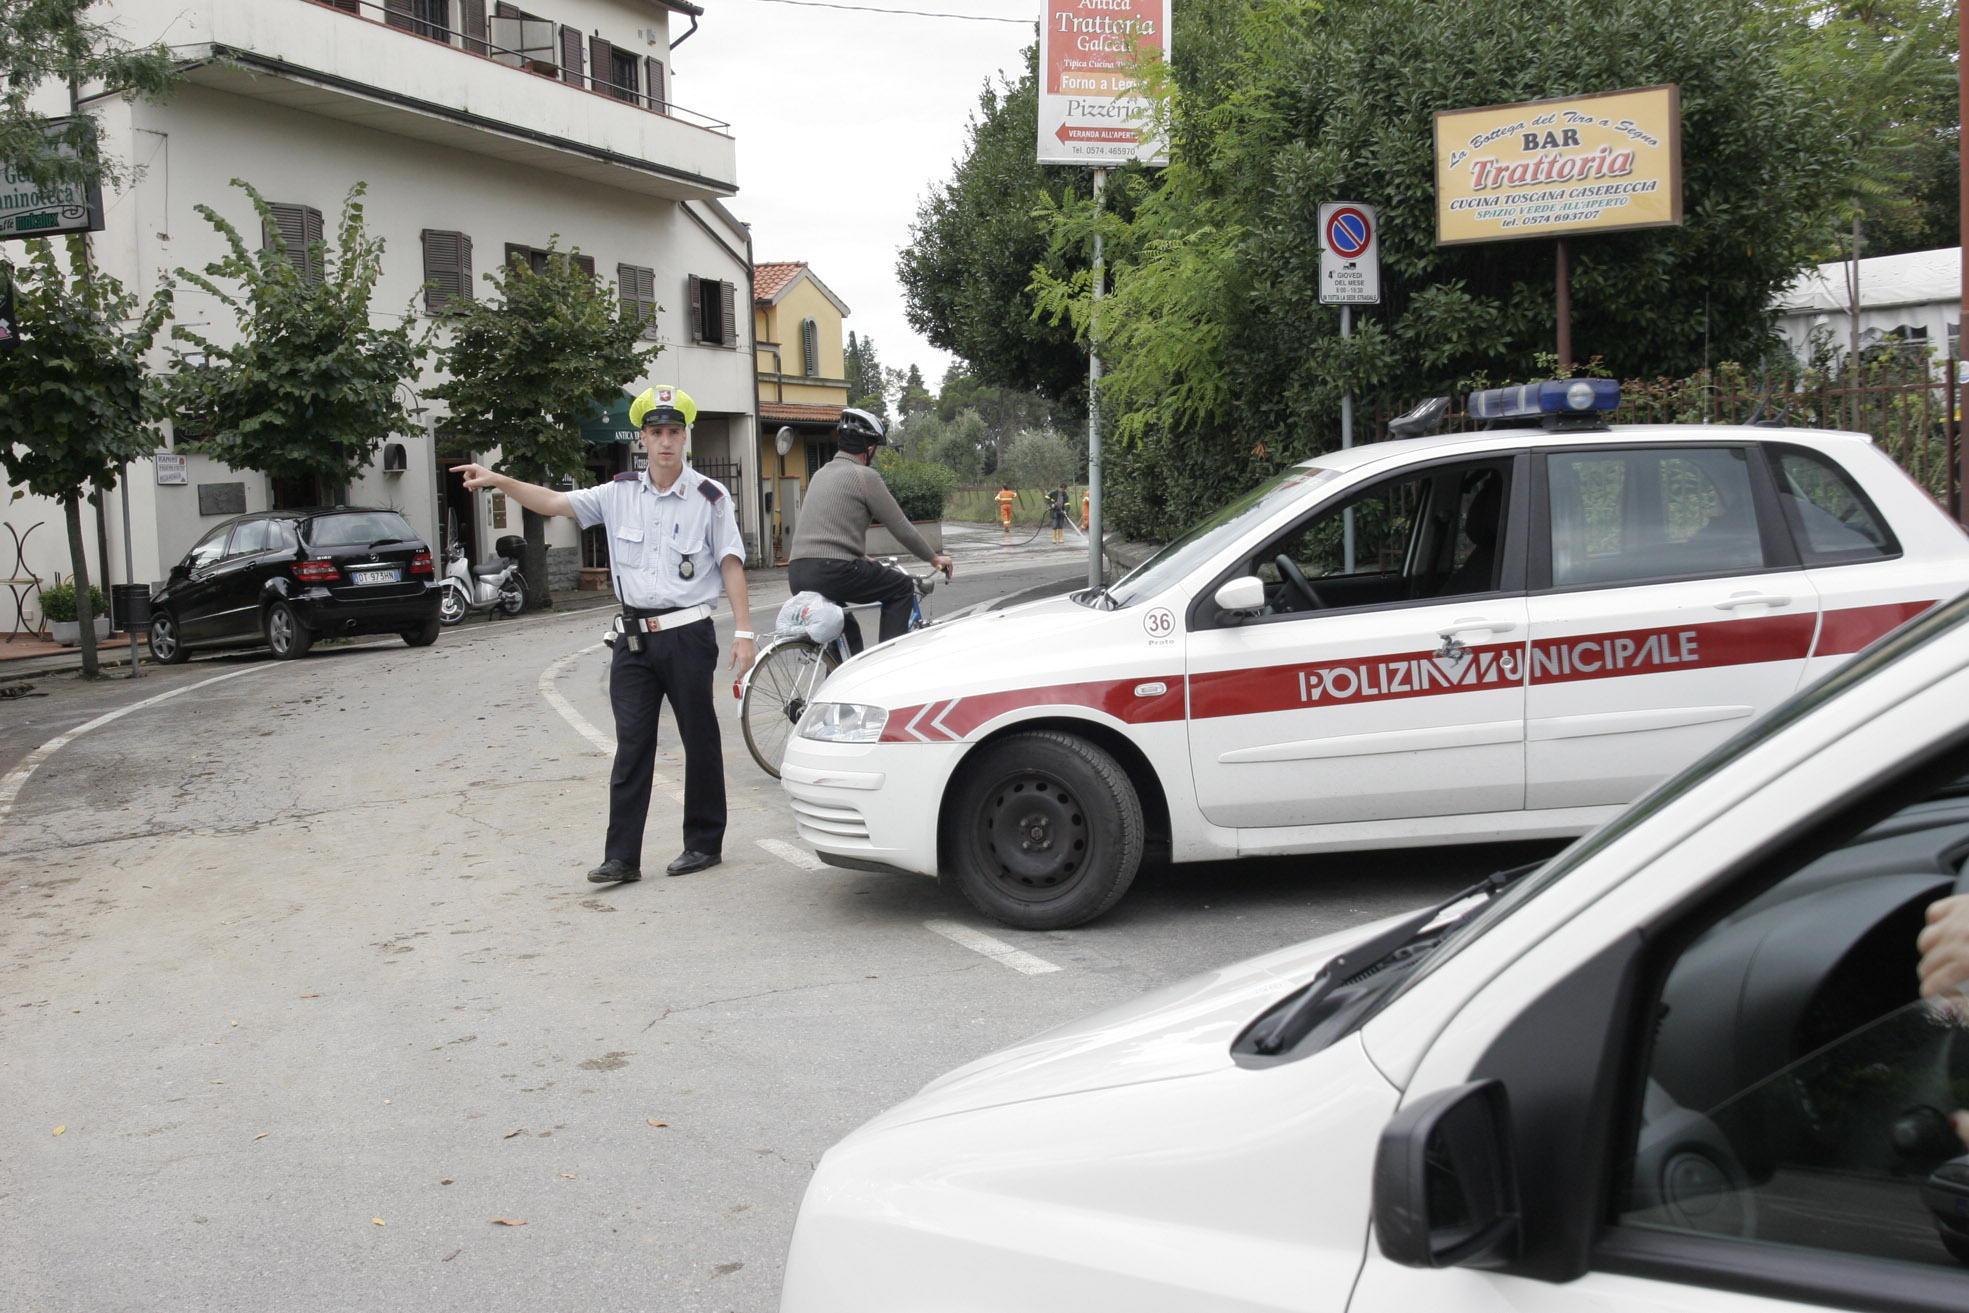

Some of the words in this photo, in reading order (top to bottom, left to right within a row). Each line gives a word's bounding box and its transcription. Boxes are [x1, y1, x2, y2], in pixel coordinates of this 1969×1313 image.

[1056, 12, 1155, 35] Trattoria
[1062, 76, 1095, 89] Forno
[1100, 79, 1107, 89] a
[1065, 99, 1141, 118] Pizzeria
[1068, 130, 1099, 138] VERANDA
[1450, 150, 1467, 168] La
[1470, 122, 1525, 148] Bottega
[1532, 113, 1555, 126] del
[1615, 120, 1658, 145] Segno
[1522, 128, 1580, 151] BAR
[1473, 146, 1632, 189] Trattoria
[1450, 196, 1500, 210] CUCINA
[1504, 190, 1565, 205] TOSCANA
[1569, 181, 1657, 198] CASERECCIA
[1476, 207, 1517, 219] SPAZIO
[1520, 203, 1557, 214] VERDE
[1560, 197, 1628, 210] ALL'APERTO
[1523, 215, 1550, 225] 0574
[1149, 613, 1170, 632] 36
